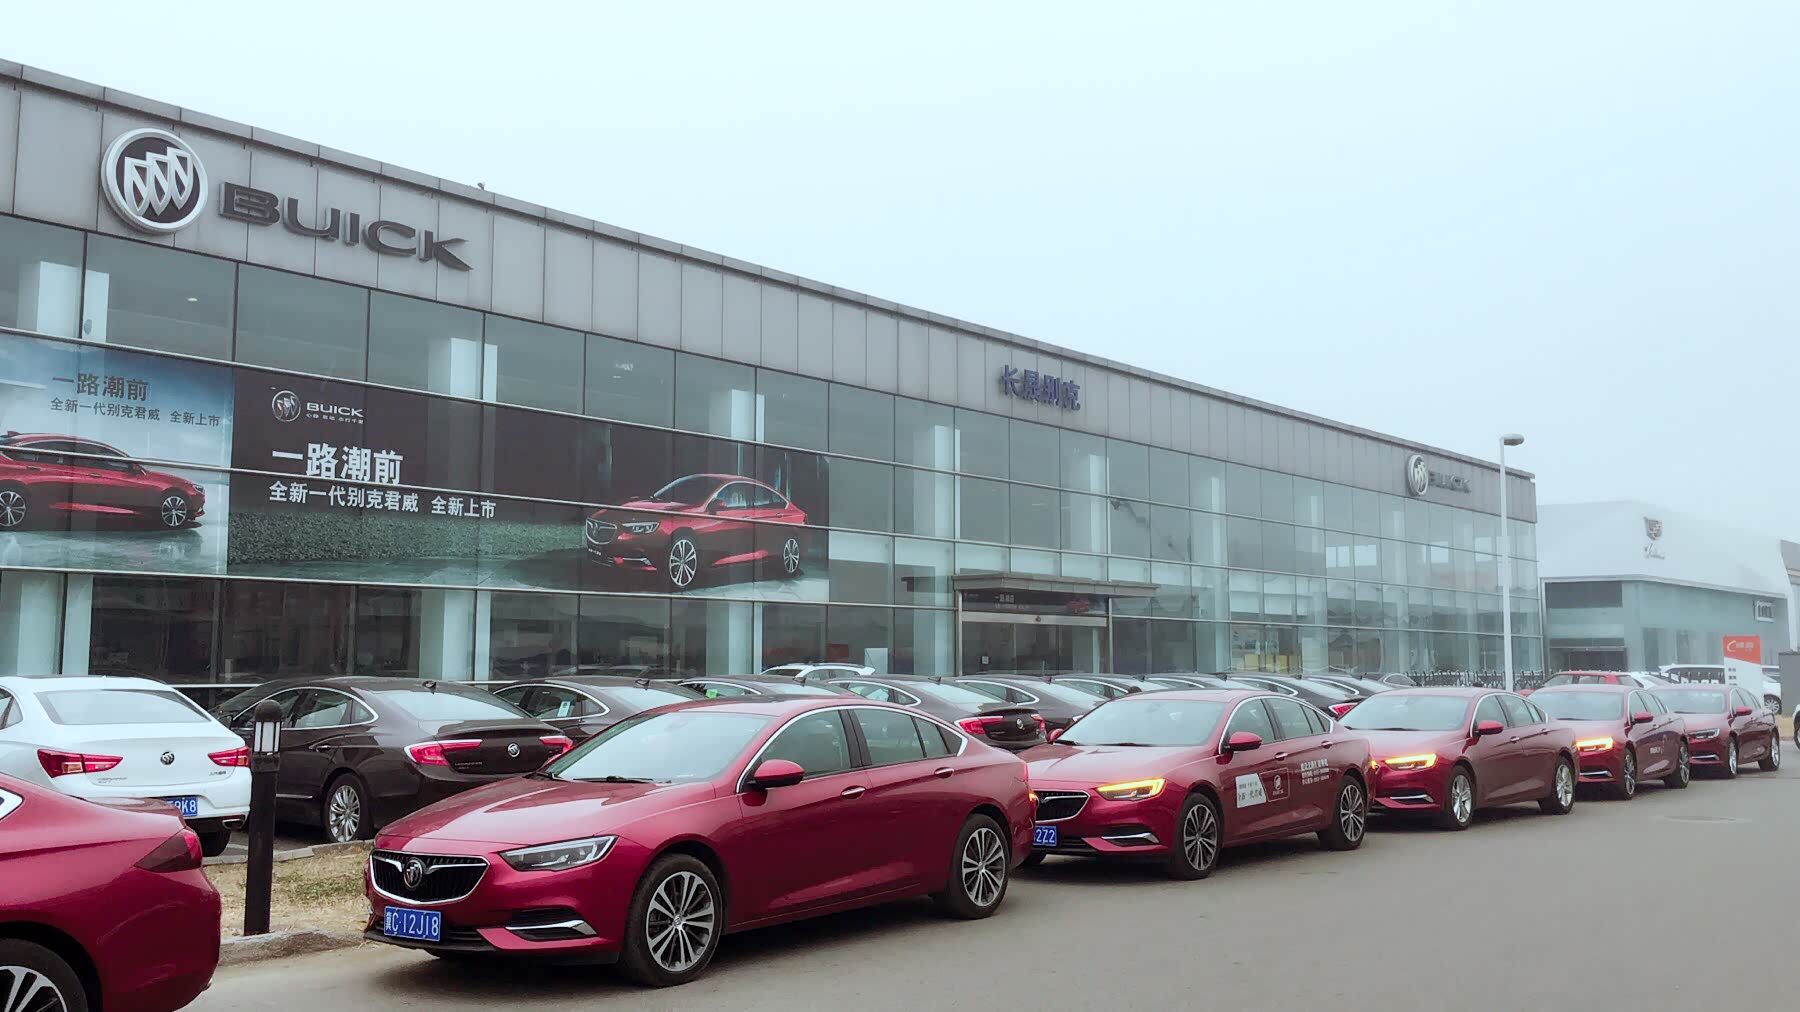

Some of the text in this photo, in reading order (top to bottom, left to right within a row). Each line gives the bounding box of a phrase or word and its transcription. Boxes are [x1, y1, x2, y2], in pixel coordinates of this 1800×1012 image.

[219, 182, 473, 270] BUICK
[52, 372, 149, 401] 一路潮前
[50, 396, 221, 428] 全新一代别克君威 全新上市
[306, 402, 364, 418] BUICK
[272, 442, 404, 485] 一路潮前
[269, 480, 497, 519] 全新一代别克君威 全新上市
[166, 799, 197, 813] 9K8
